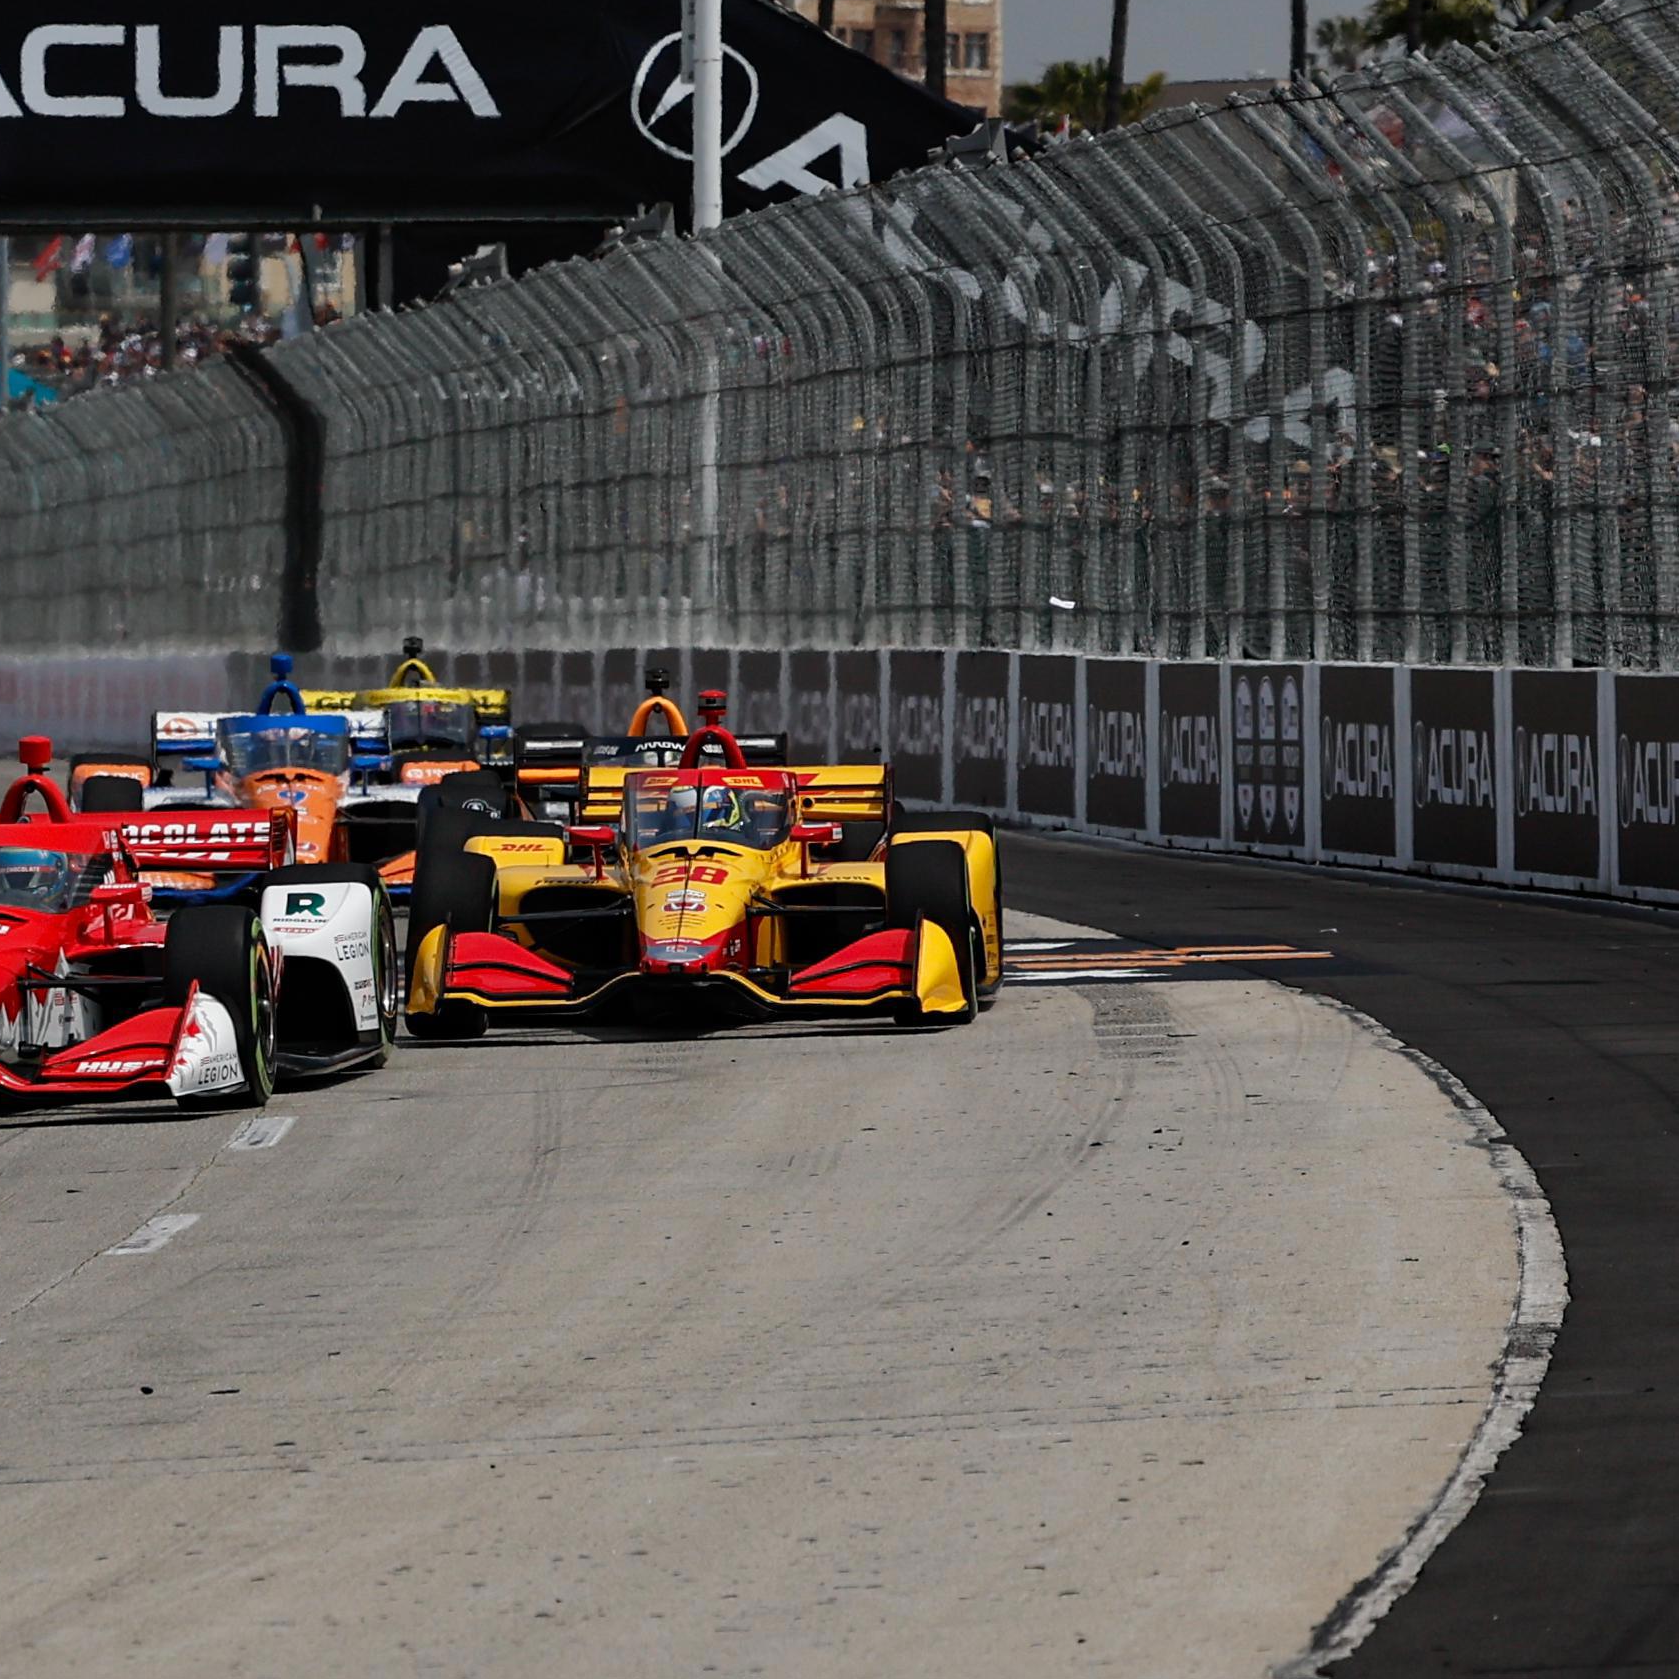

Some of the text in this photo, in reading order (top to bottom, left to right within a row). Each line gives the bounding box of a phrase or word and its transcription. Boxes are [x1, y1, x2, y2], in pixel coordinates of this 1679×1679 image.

[1097, 710, 1143, 777] ACURA
[1170, 714, 1221, 784] ACURA
[1333, 722, 1394, 799] ACURA
[1427, 727, 1496, 809] ACURA
[731, 777, 760, 785] DHL
[1528, 732, 1597, 816] ACURA
[123, 822, 271, 845] OCOLATE
[500, 843, 546, 852] DHL
[651, 865, 729, 888] 28
[286, 892, 326, 917] R
[335, 941, 370, 961] LEGION
[198, 1064, 239, 1086] LEGION
